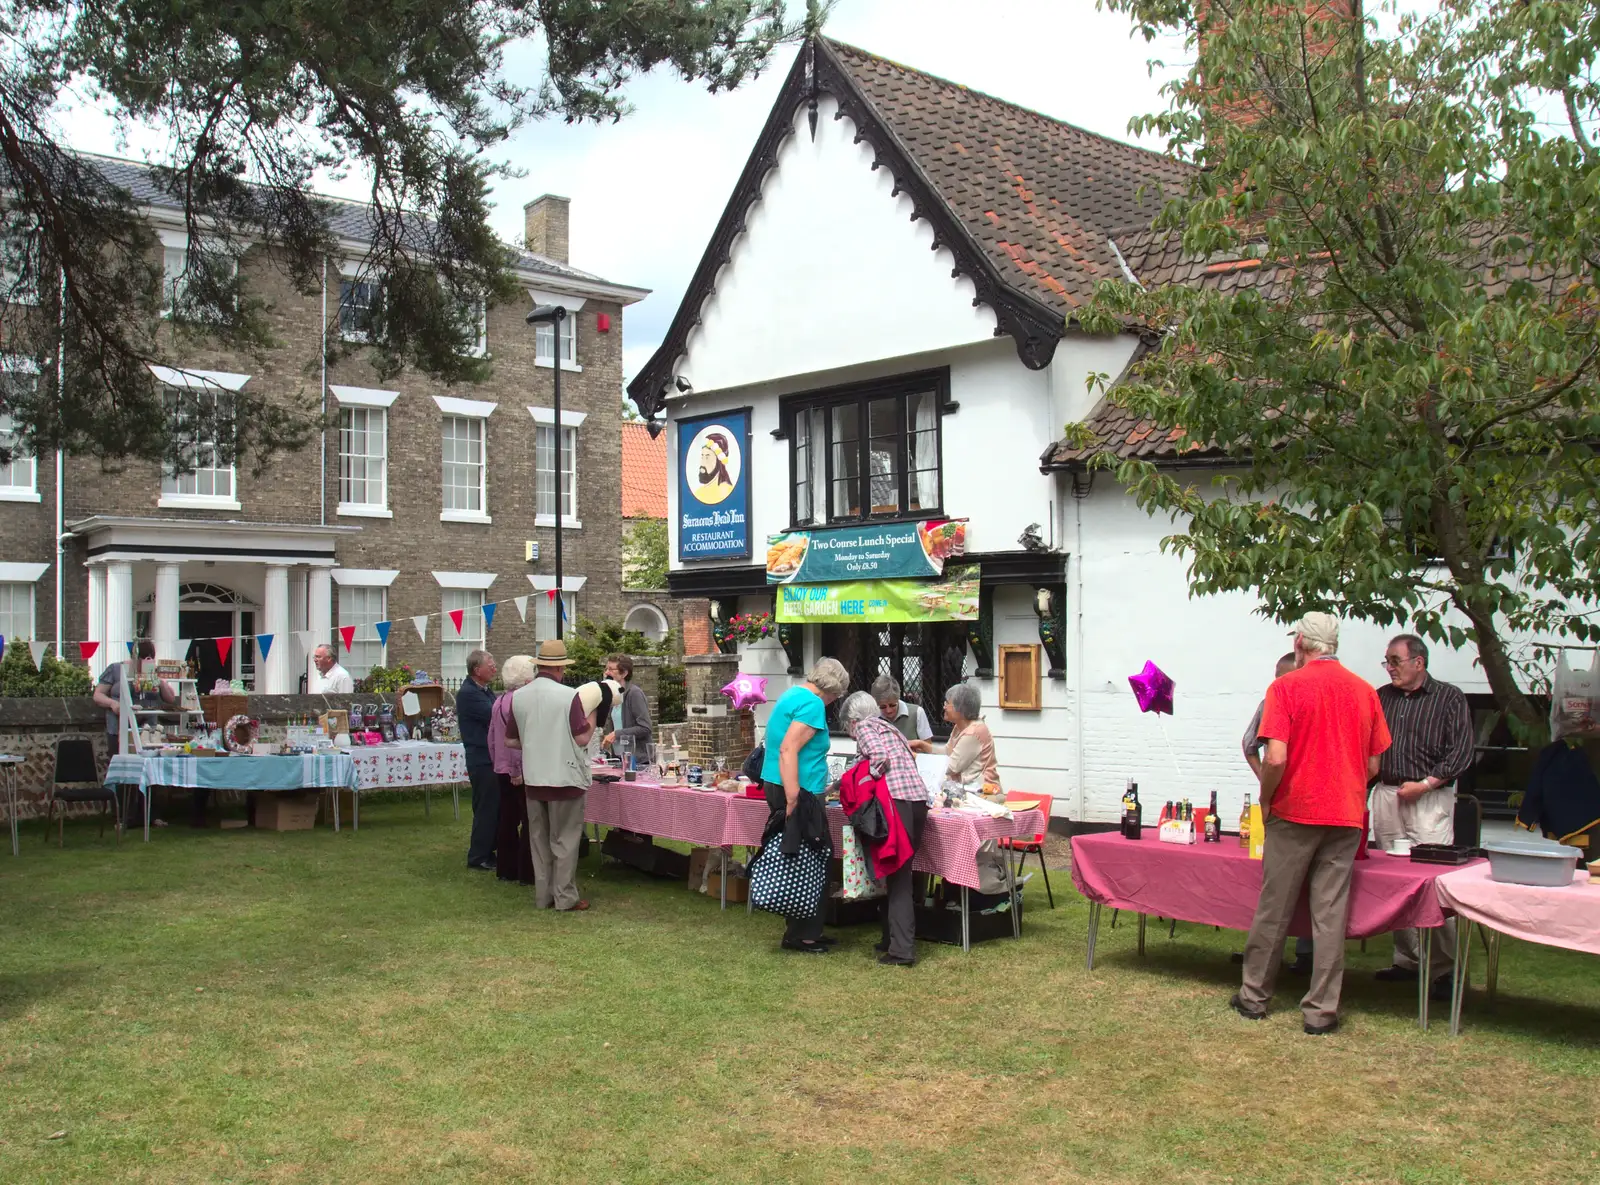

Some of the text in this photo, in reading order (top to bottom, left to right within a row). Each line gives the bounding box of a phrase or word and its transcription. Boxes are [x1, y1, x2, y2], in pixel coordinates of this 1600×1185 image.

[712, 510, 731, 527] Head
[730, 509, 745, 525] Inn
[692, 531, 734, 542] RESTAURANT
[812, 532, 916, 550] Two Course Lunch Special
[684, 540, 744, 552] ACCOMMODATION
[834, 552, 858, 562] Monday
[865, 550, 891, 560] Saturday
[846, 561, 878, 572] Only £8.50
[783, 587, 828, 601] ENJOY OUR
[783, 601, 803, 616] BEER
[803, 600, 838, 616] GARDEN
[840, 599, 865, 615] HERE
